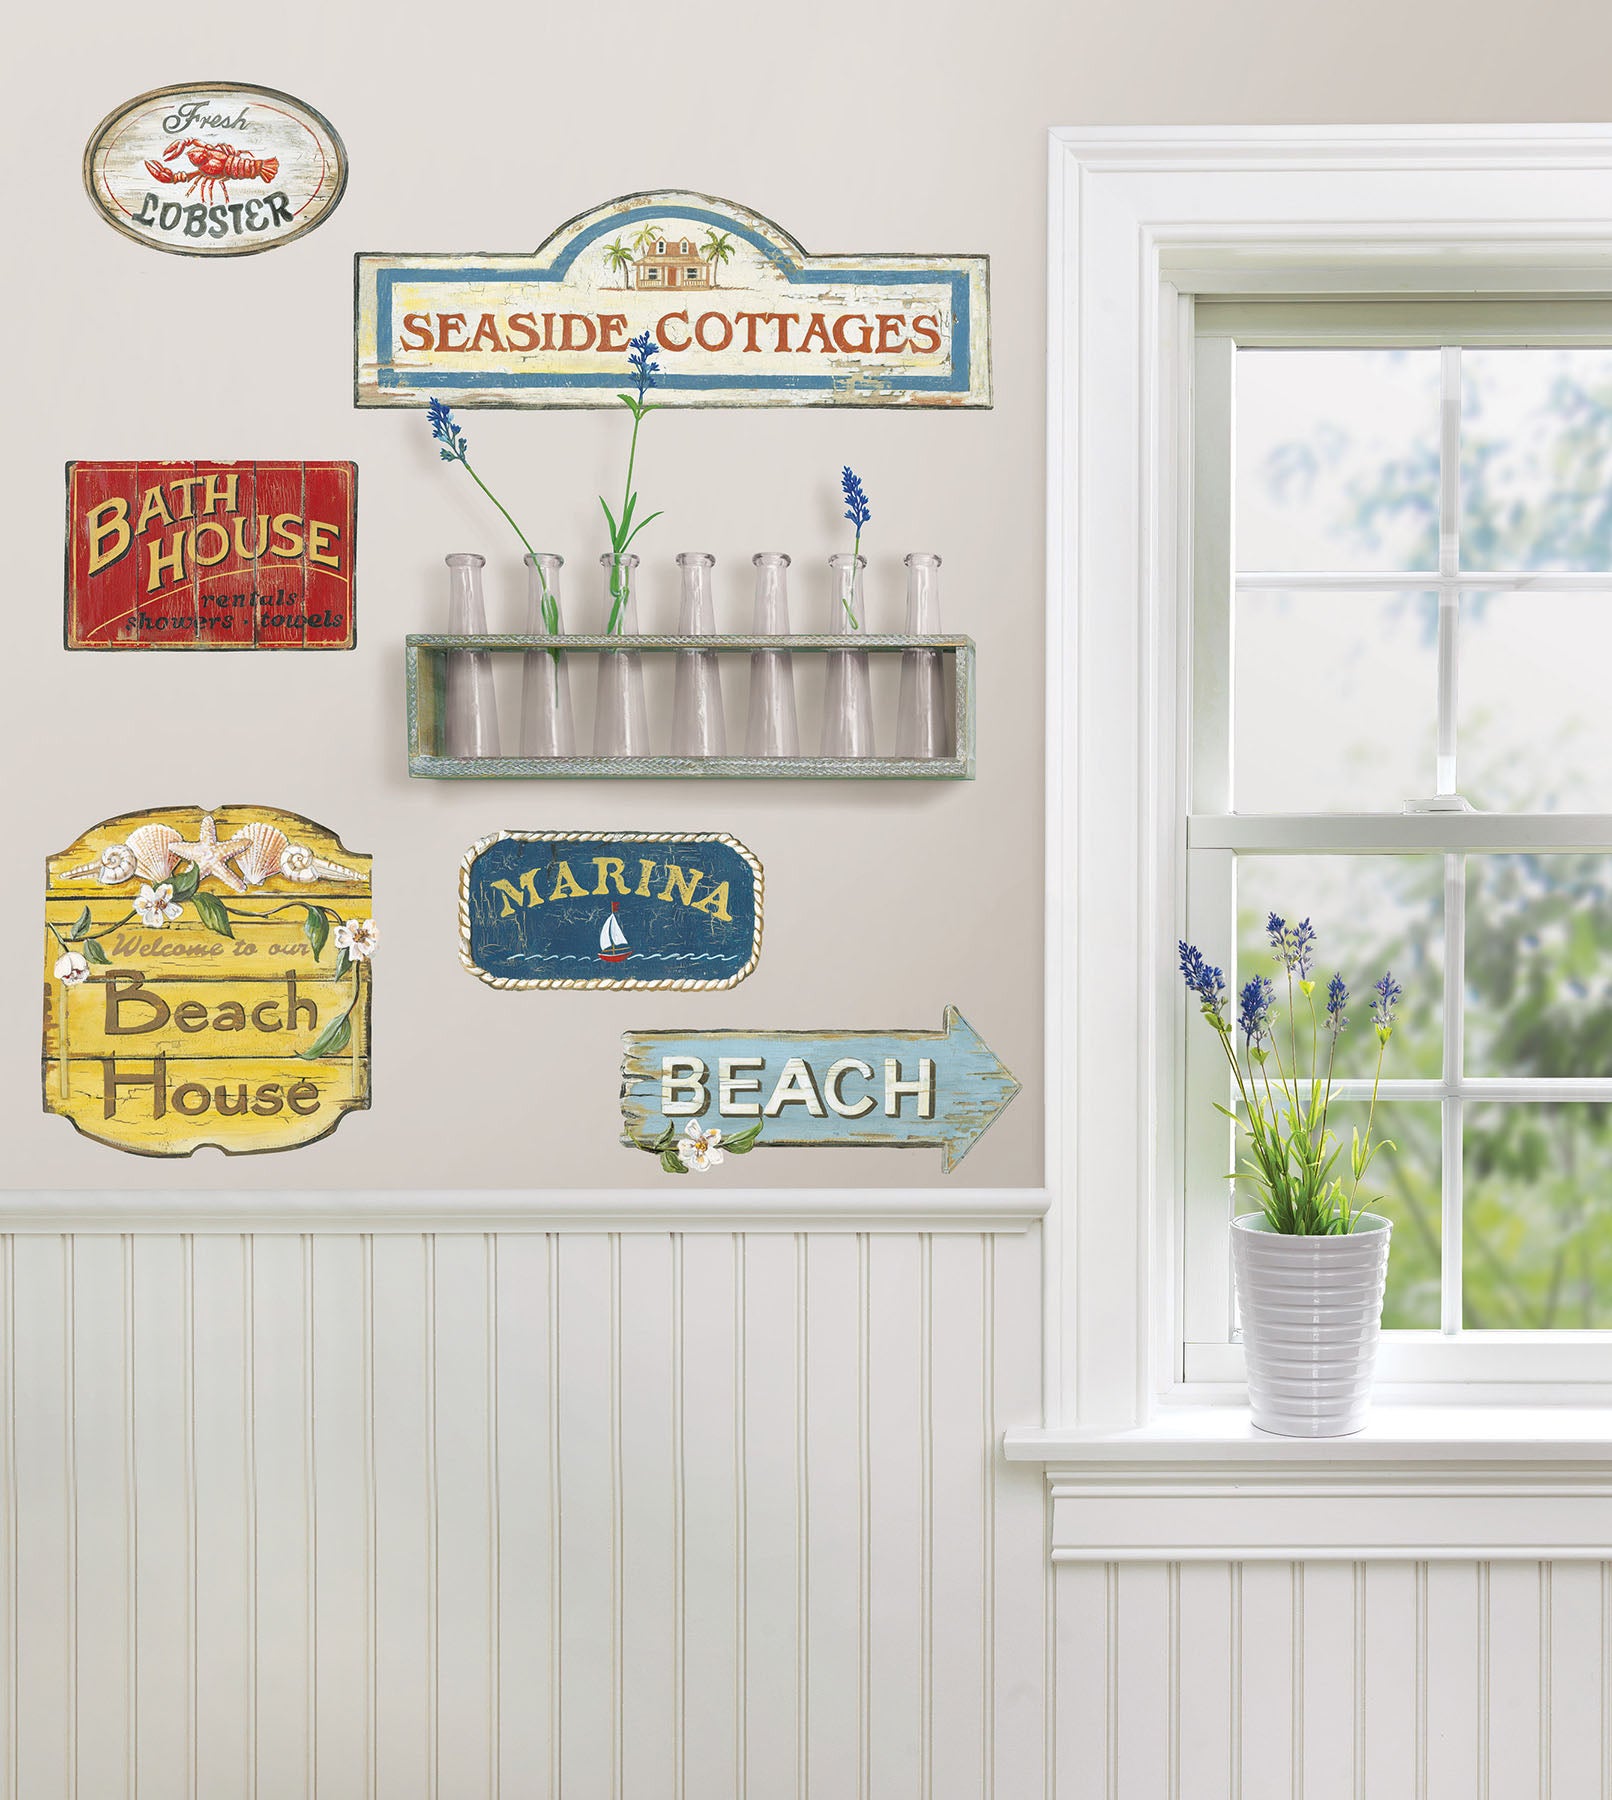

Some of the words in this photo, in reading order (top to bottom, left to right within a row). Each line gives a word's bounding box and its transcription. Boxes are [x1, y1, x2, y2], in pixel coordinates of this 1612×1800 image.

[162, 100, 252, 134] Fresh
[132, 191, 295, 239] LOBSTER
[399, 312, 630, 353] SEASIDE
[655, 311, 942, 354] COTTAGES
[86, 473, 240, 577] BATH
[146, 513, 342, 593] HOUSE
[125, 611, 234, 631] showers
[261, 609, 343, 628] towels
[201, 589, 297, 608] rentals
[490, 856, 733, 922] MARINA
[111, 933, 225, 957] Welcome
[232, 938, 257, 957] to
[268, 941, 311, 957] our
[103, 969, 319, 1036] Beach
[102, 1050, 321, 1120] House
[661, 1056, 936, 1119] BEACH
